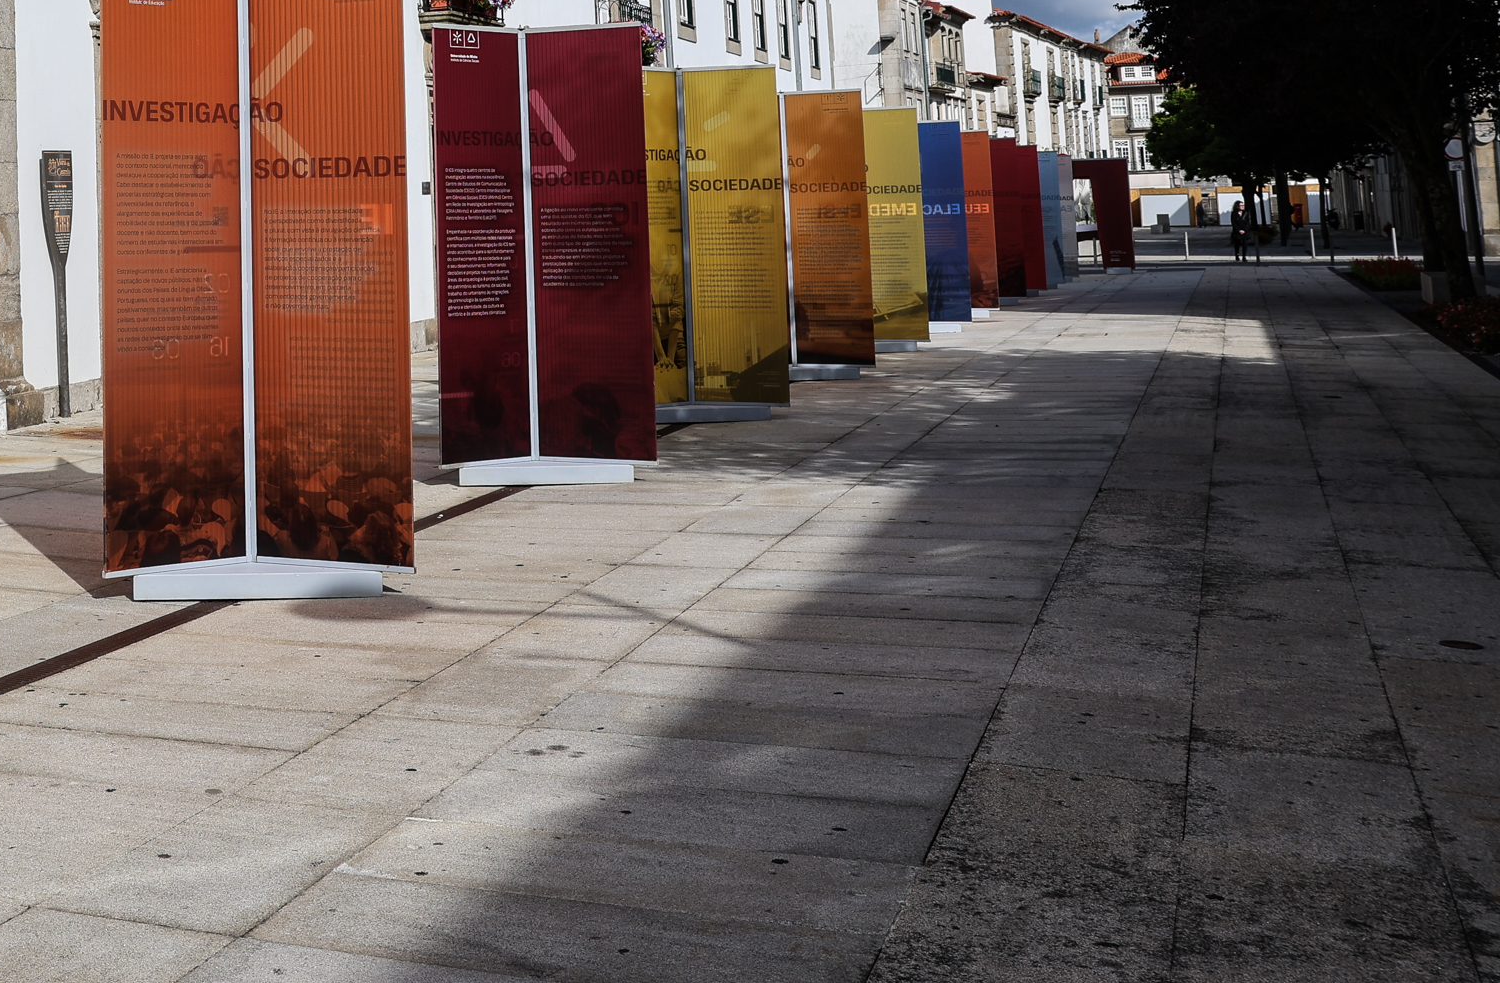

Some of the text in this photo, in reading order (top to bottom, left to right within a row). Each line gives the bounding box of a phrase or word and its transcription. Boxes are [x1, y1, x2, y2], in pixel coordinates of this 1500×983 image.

[103, 98, 283, 129] INVESTIGAÇÃO
[254, 155, 406, 179] SOCIEDADE
[532, 169, 646, 187] SOCIEDADE
[689, 178, 781, 192] SOCIEDADE
[790, 181, 866, 194] SOCIEDADE
